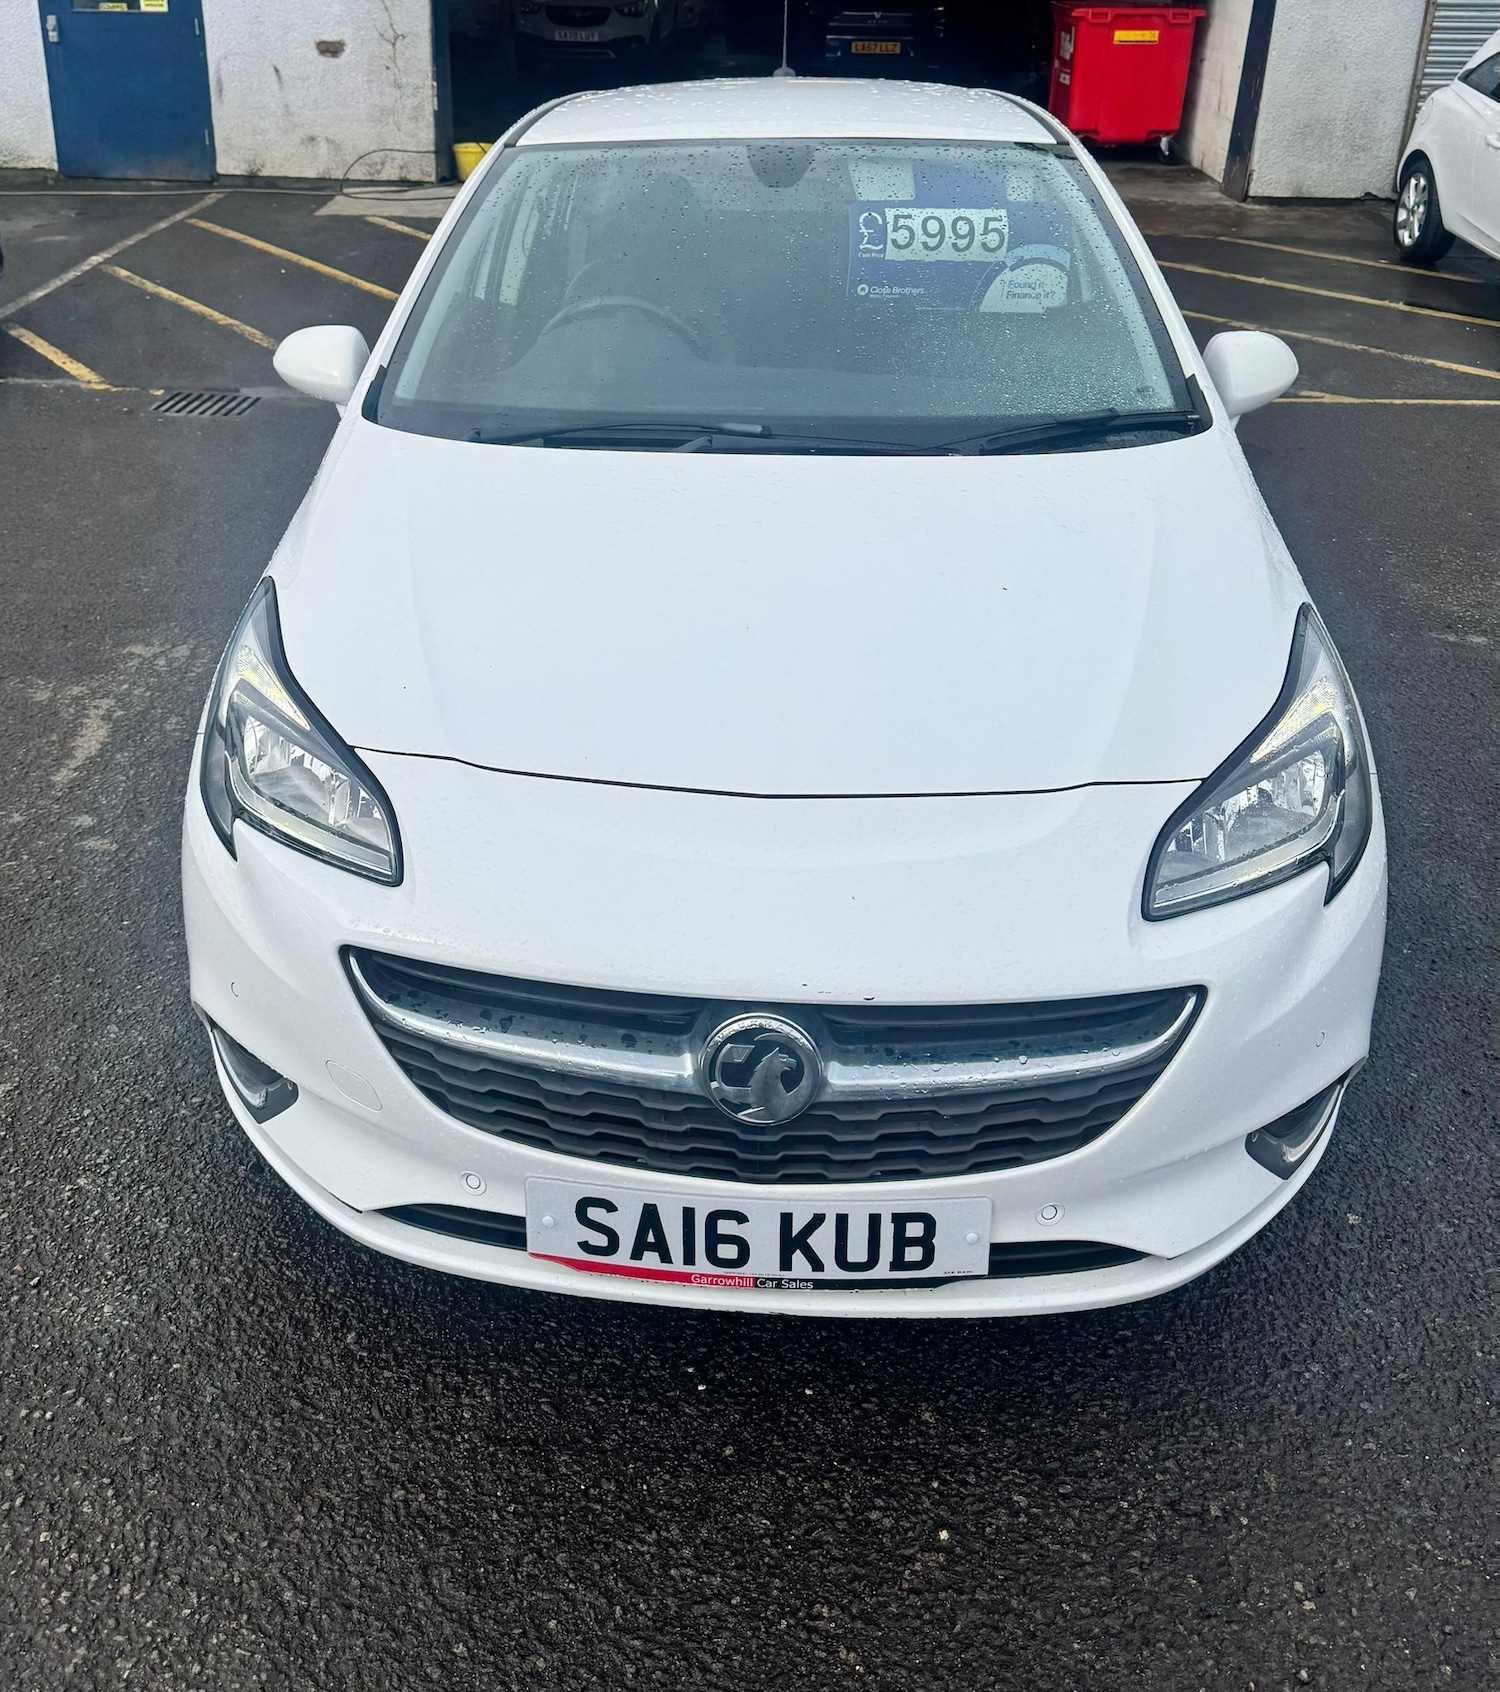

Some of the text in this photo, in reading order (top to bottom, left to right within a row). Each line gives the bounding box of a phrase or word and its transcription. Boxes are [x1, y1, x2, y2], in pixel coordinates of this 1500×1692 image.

[870, 286, 924, 294] Close Brothers
[574, 1196, 937, 1273] SA16 KUB
[690, 1273, 754, 1288] Garrowhill
[757, 1279, 778, 1288] Car
[781, 1279, 814, 1289] Sales
